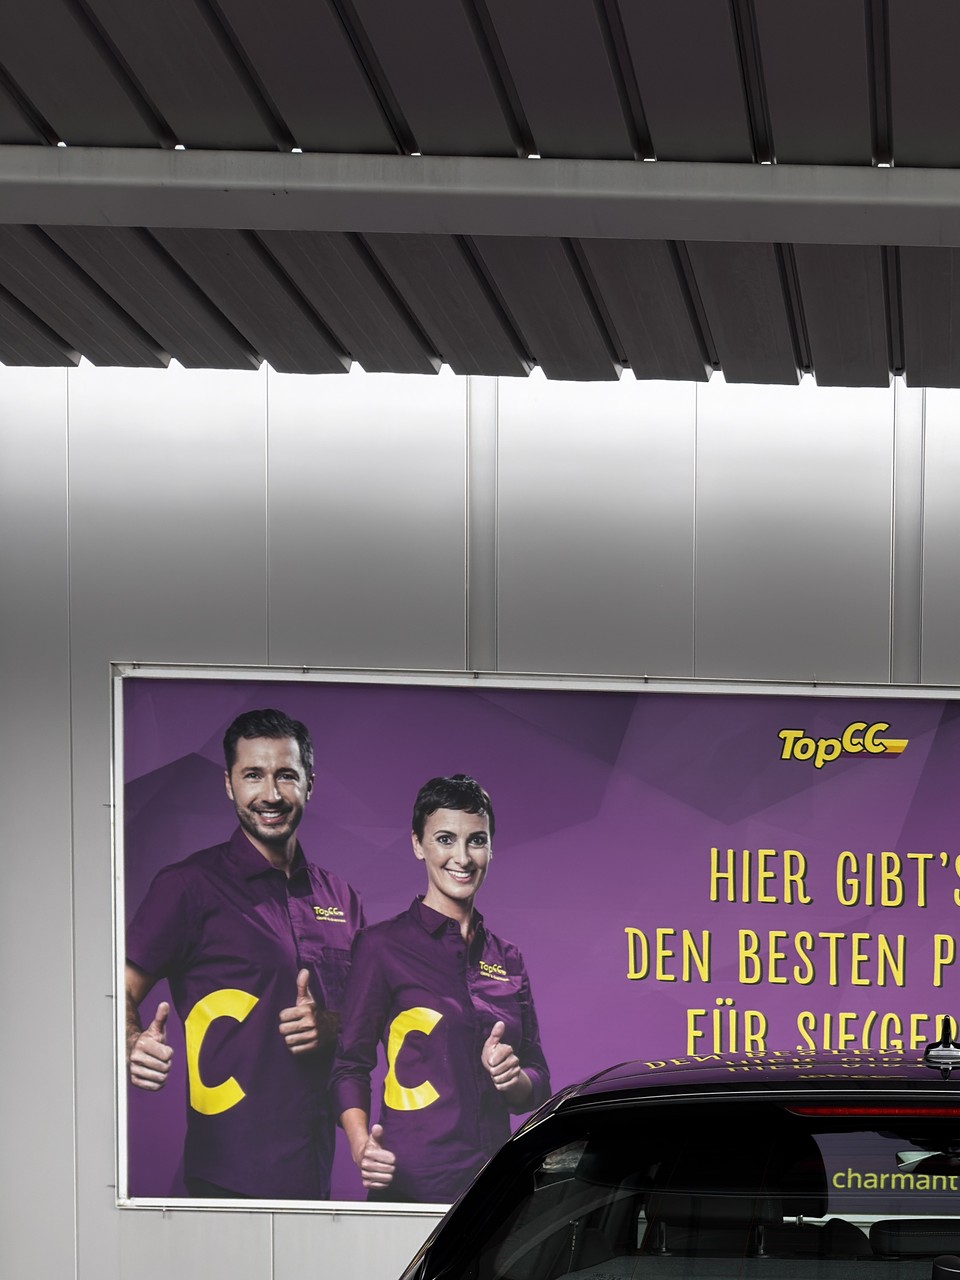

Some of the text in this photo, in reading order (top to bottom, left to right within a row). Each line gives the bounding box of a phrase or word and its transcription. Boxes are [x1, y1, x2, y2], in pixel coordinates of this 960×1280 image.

[778, 721, 892, 770] TopCC
[709, 847, 813, 904] HIER
[624, 927, 711, 983] DEN
[738, 929, 906, 988] BESTEN
[185, 988, 260, 1116] C
[686, 997, 768, 1057] FÜR
[383, 1006, 442, 1112] C
[831, 1167, 959, 1191] charmant
